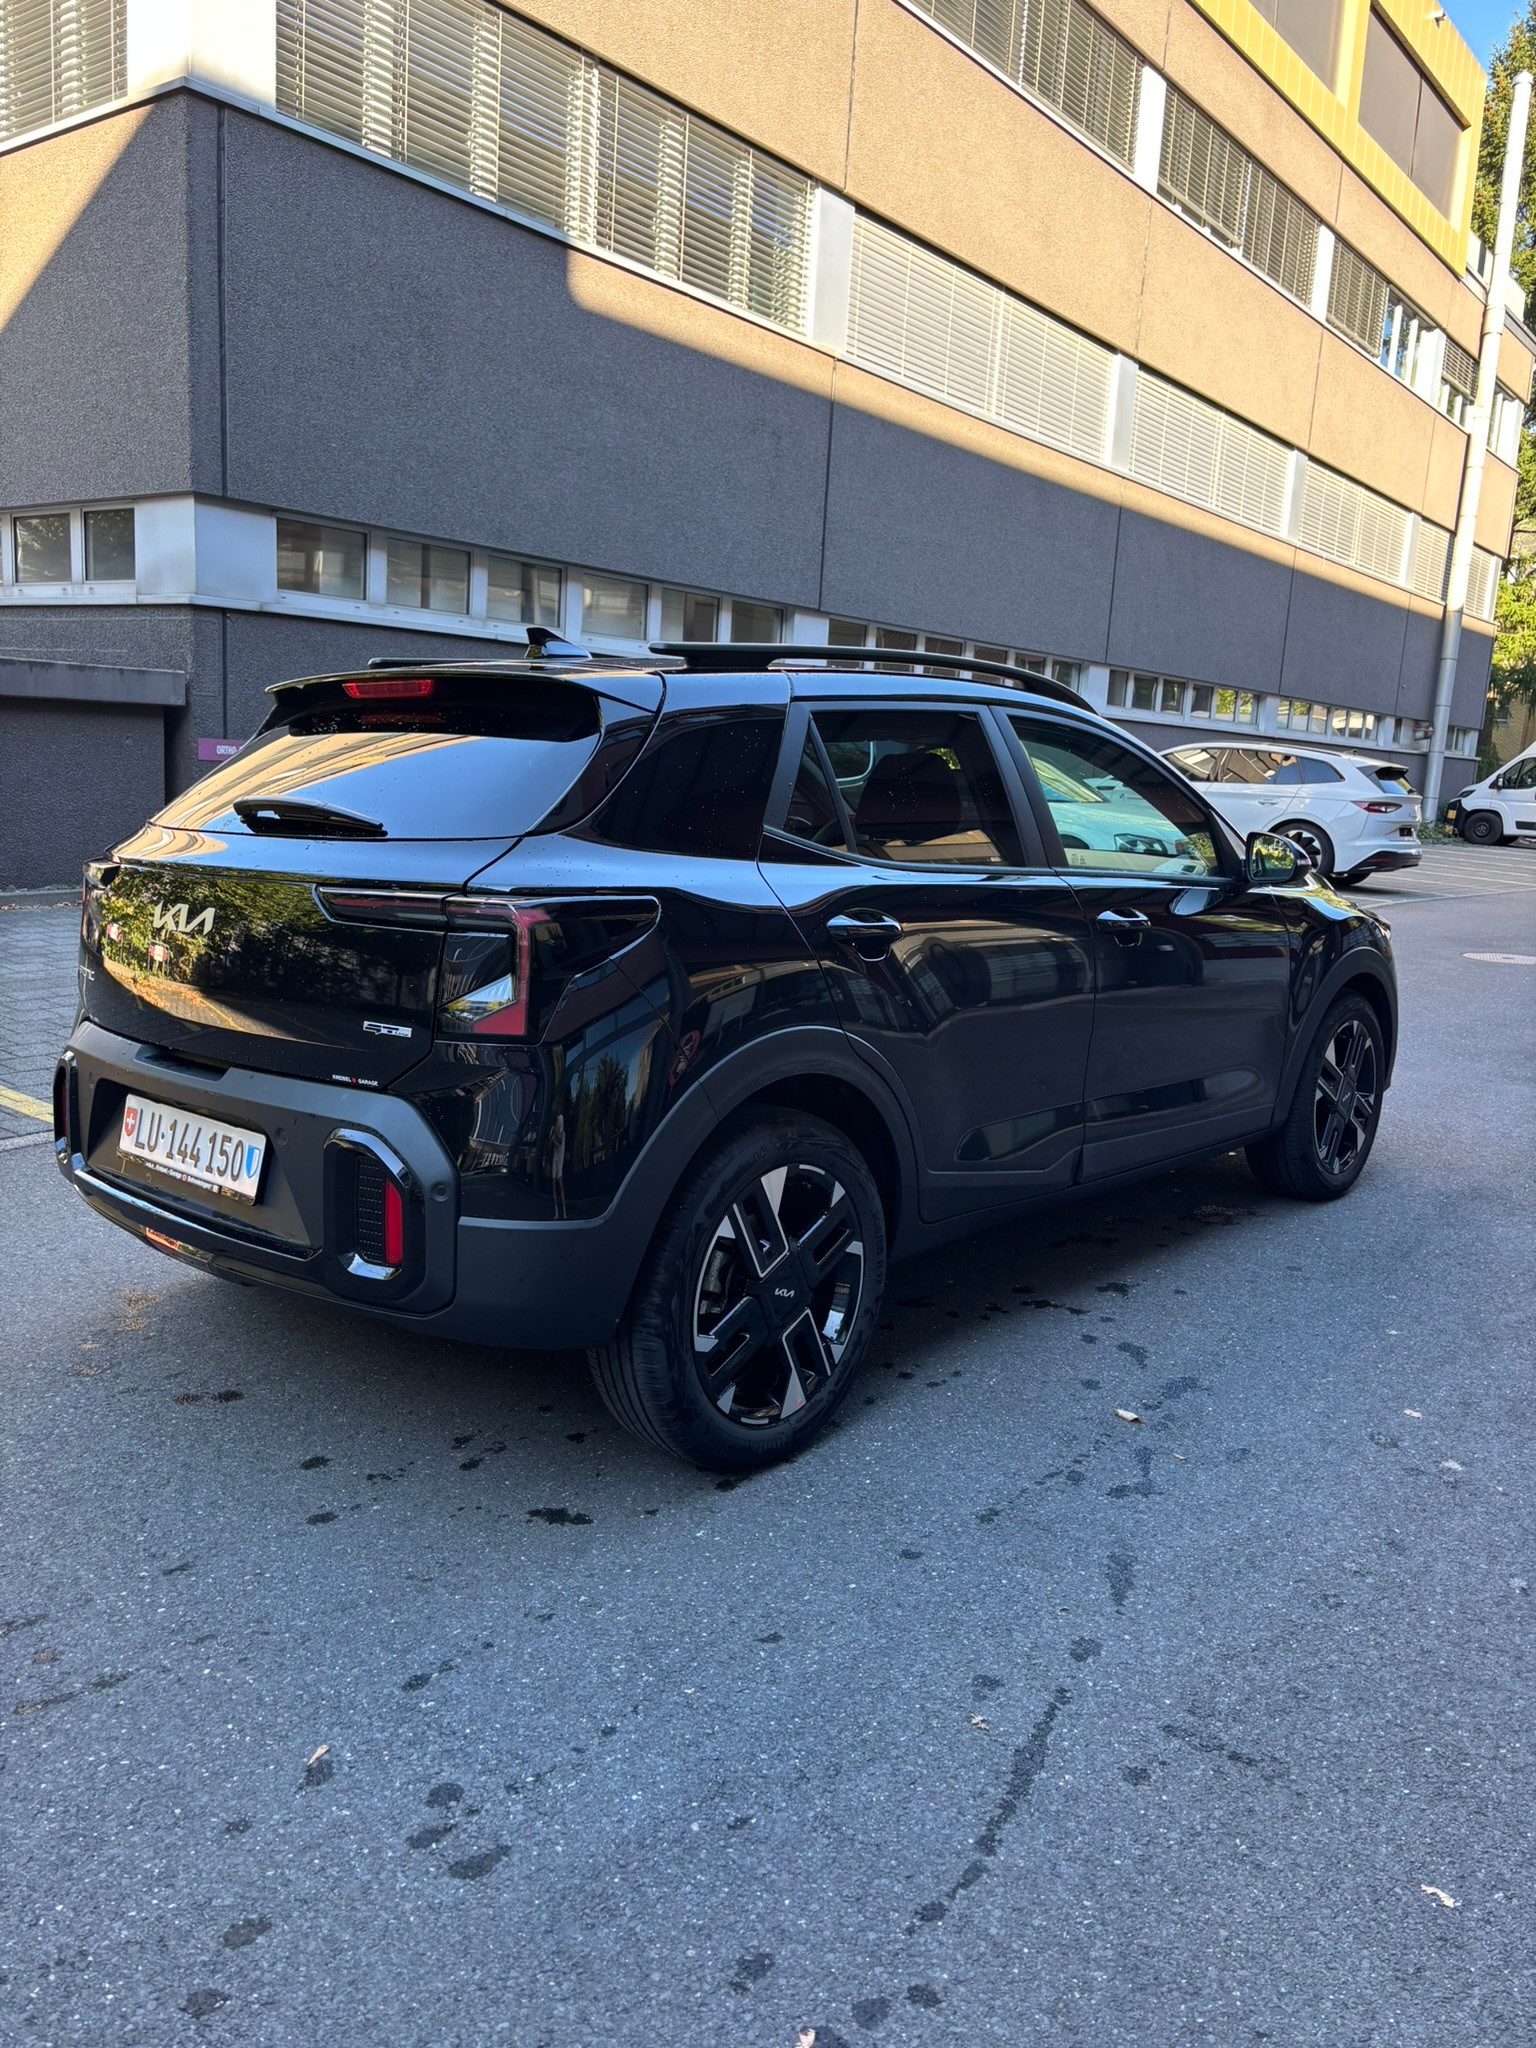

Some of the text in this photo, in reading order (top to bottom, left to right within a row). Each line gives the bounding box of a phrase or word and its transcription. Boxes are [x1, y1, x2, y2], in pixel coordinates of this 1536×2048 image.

[152, 900, 216, 936] KIA
[357, 1078, 379, 1087] GARAGE
[774, 1287, 795, 1298] KIA
